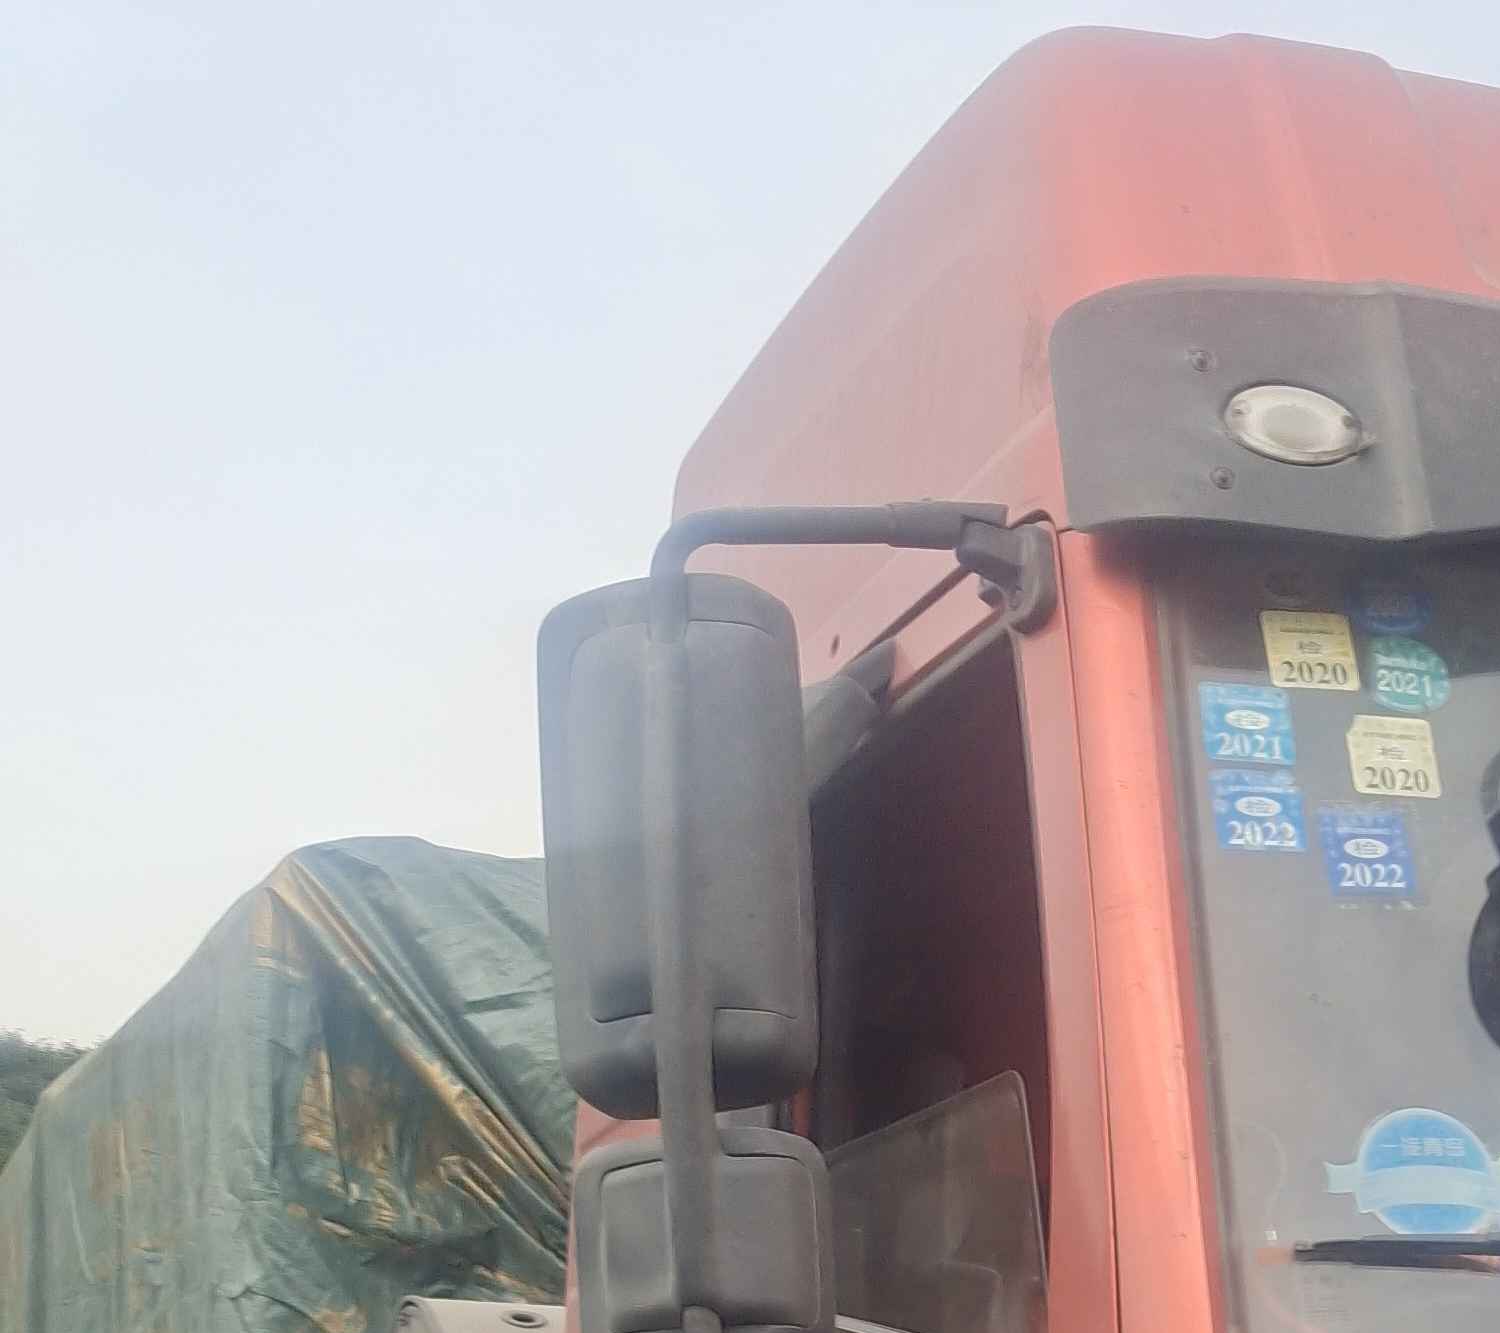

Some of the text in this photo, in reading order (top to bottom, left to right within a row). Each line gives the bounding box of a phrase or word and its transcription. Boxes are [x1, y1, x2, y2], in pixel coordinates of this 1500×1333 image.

[1281, 660, 1349, 685] 2020
[1376, 668, 1432, 698] 2021
[1216, 732, 1284, 761] 2021
[1362, 765, 1430, 793] 2020
[1228, 820, 1298, 847] 2022
[1339, 862, 1407, 889] 2022
